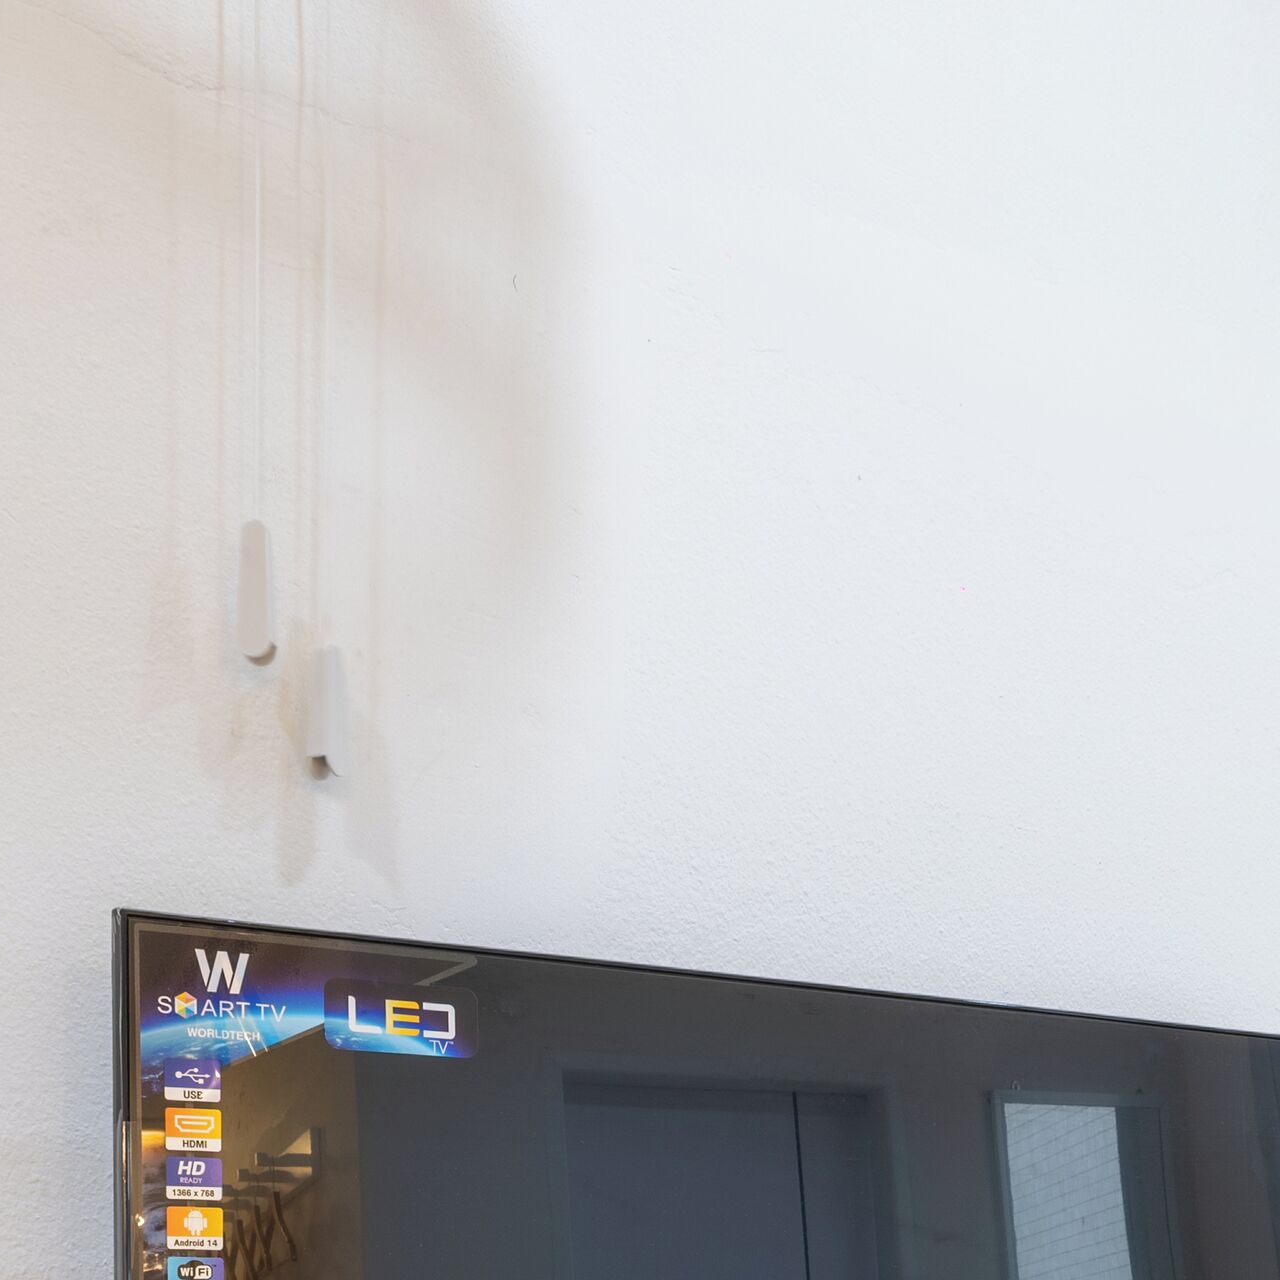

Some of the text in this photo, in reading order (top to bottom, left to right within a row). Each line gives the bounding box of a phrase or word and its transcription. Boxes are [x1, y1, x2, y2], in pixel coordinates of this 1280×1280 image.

[194, 948, 250, 994] W
[255, 1003, 287, 1023] TV
[347, 995, 456, 1041] LED
[186, 1026, 261, 1042] WORLDTECH
[182, 1139, 208, 1149] HDMI
[177, 1160, 206, 1176] HD
[179, 1176, 203, 1184] READY
[172, 1189, 192, 1197] 1366
[200, 1189, 215, 1198] 768
[173, 1239, 205, 1247] Android
